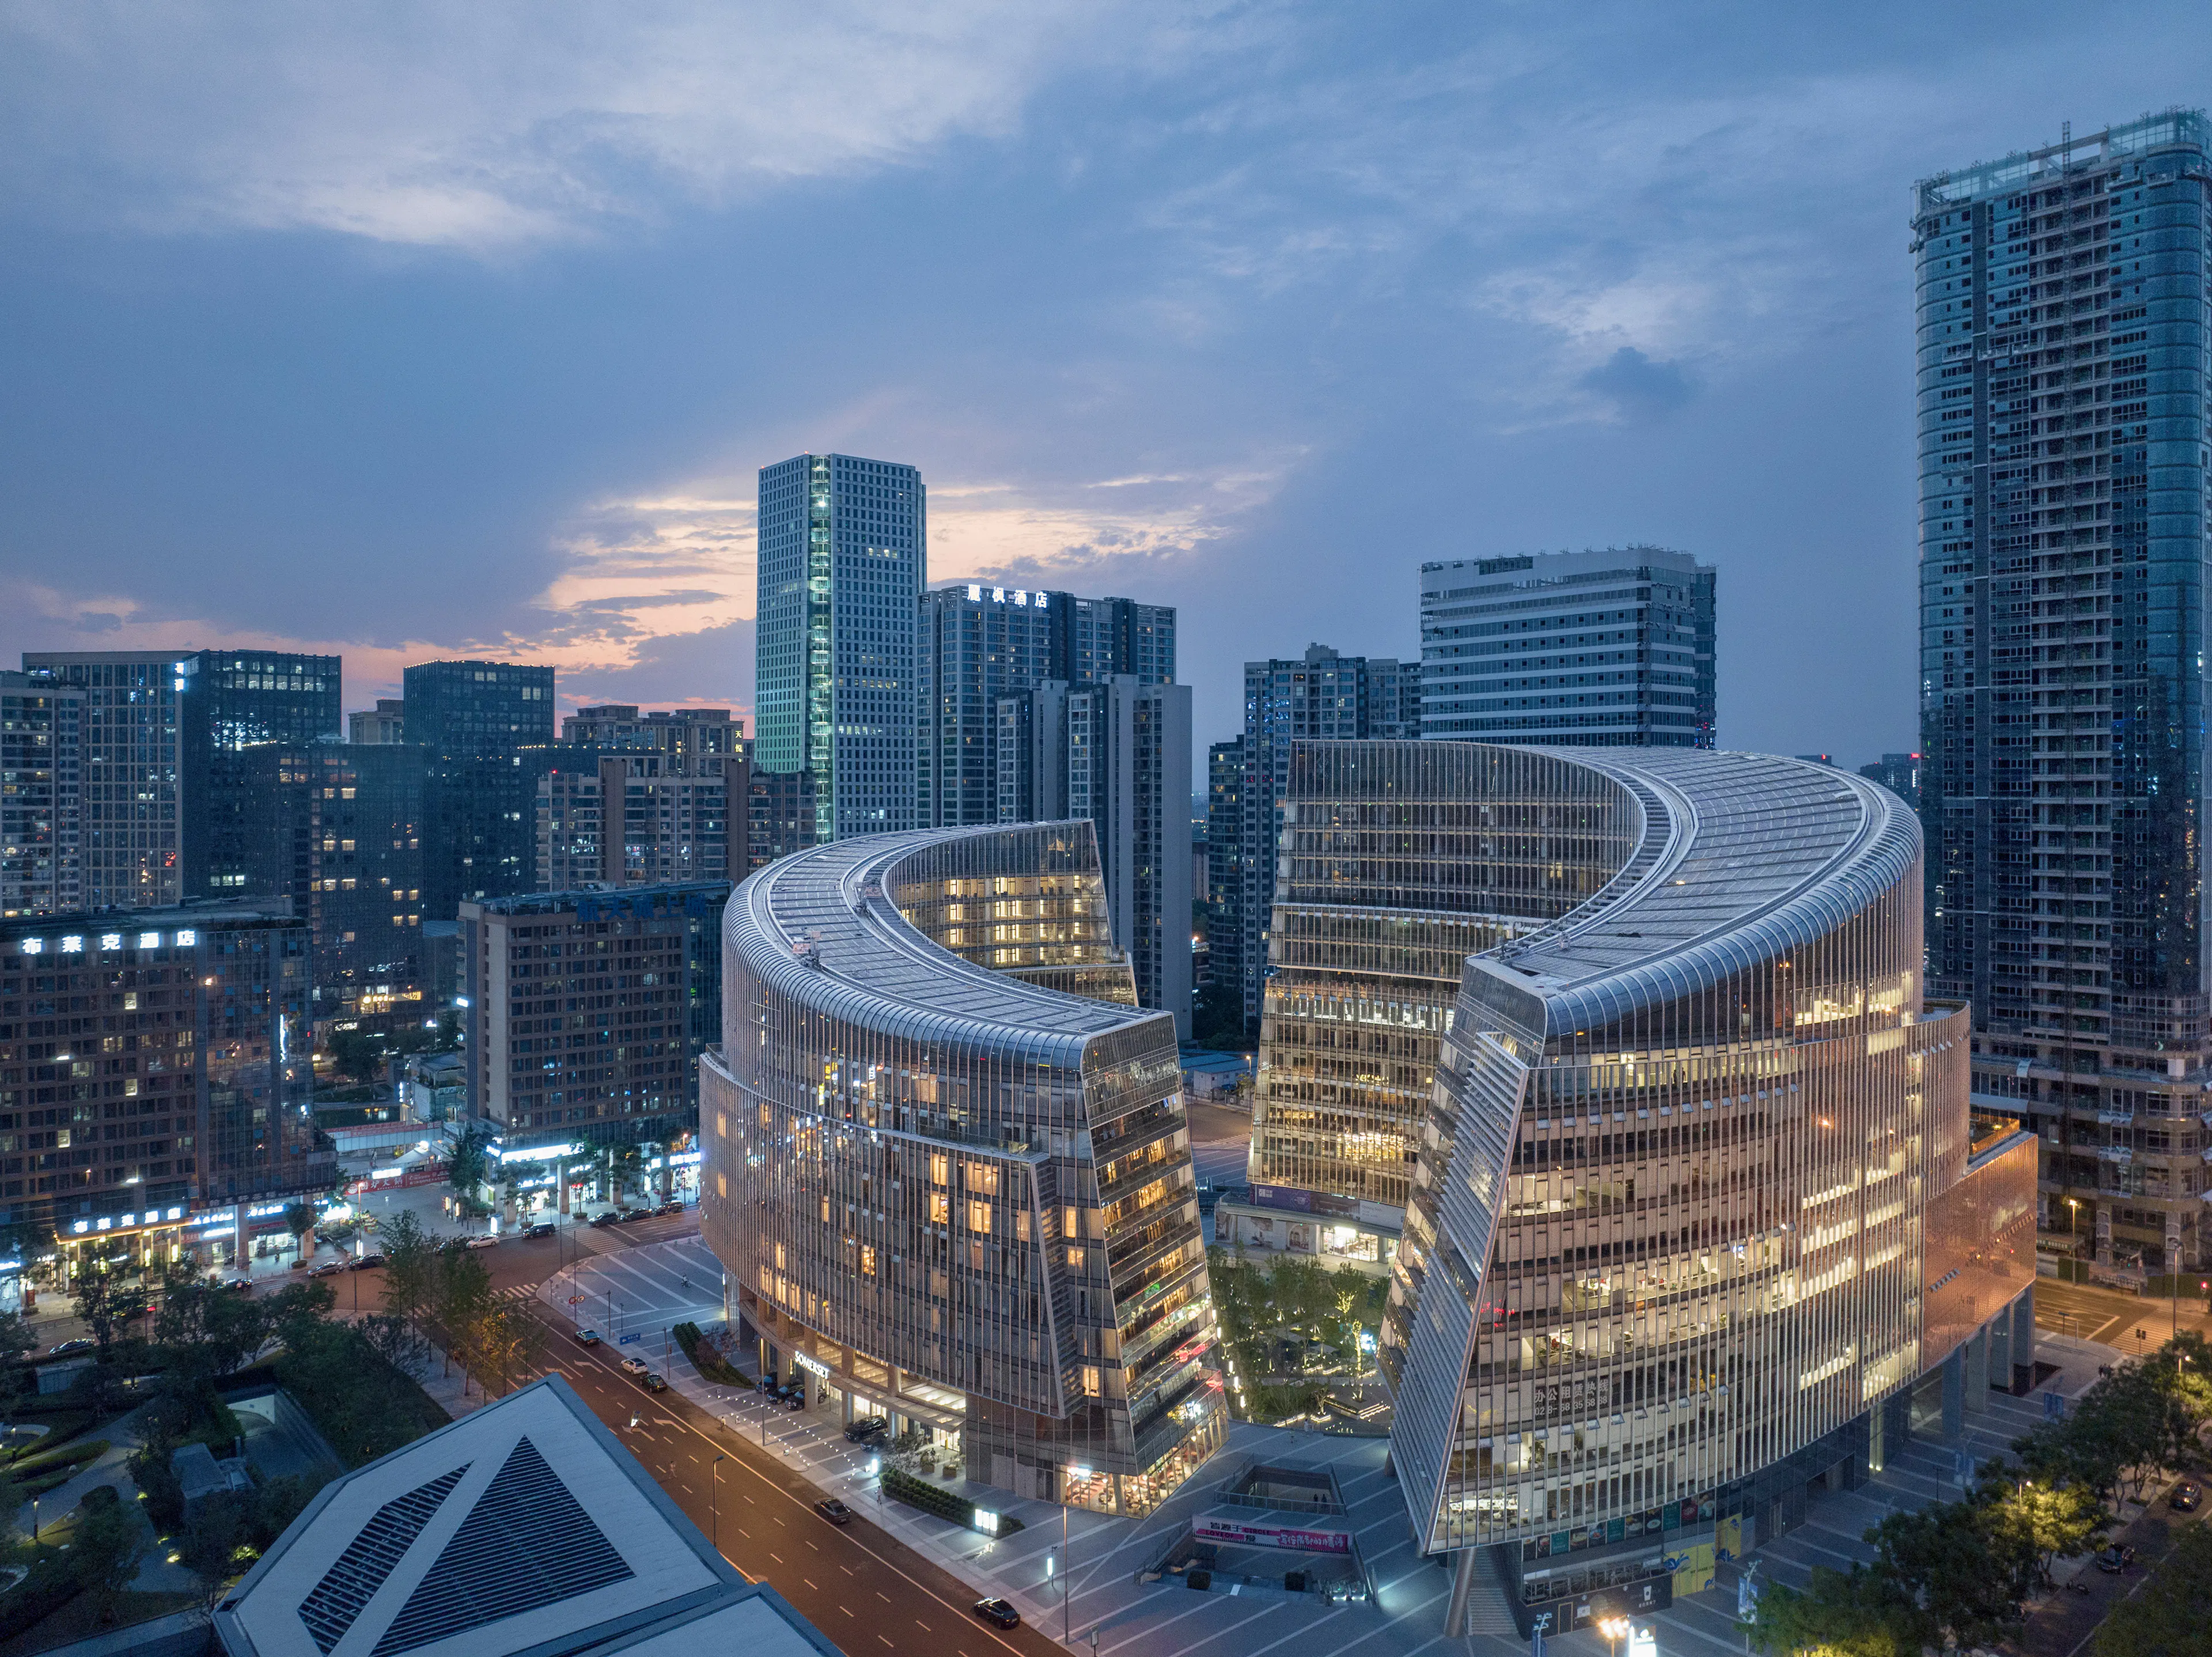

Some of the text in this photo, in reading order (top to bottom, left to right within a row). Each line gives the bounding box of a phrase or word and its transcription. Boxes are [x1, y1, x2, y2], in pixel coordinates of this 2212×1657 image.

[22, 930, 195, 955] 布莱克酒店
[794, 1350, 830, 1380] SOMERSET
[1535, 1379, 1609, 1403] 办公租赁热线
[1244, 1527, 1270, 1536] CIRCLE
